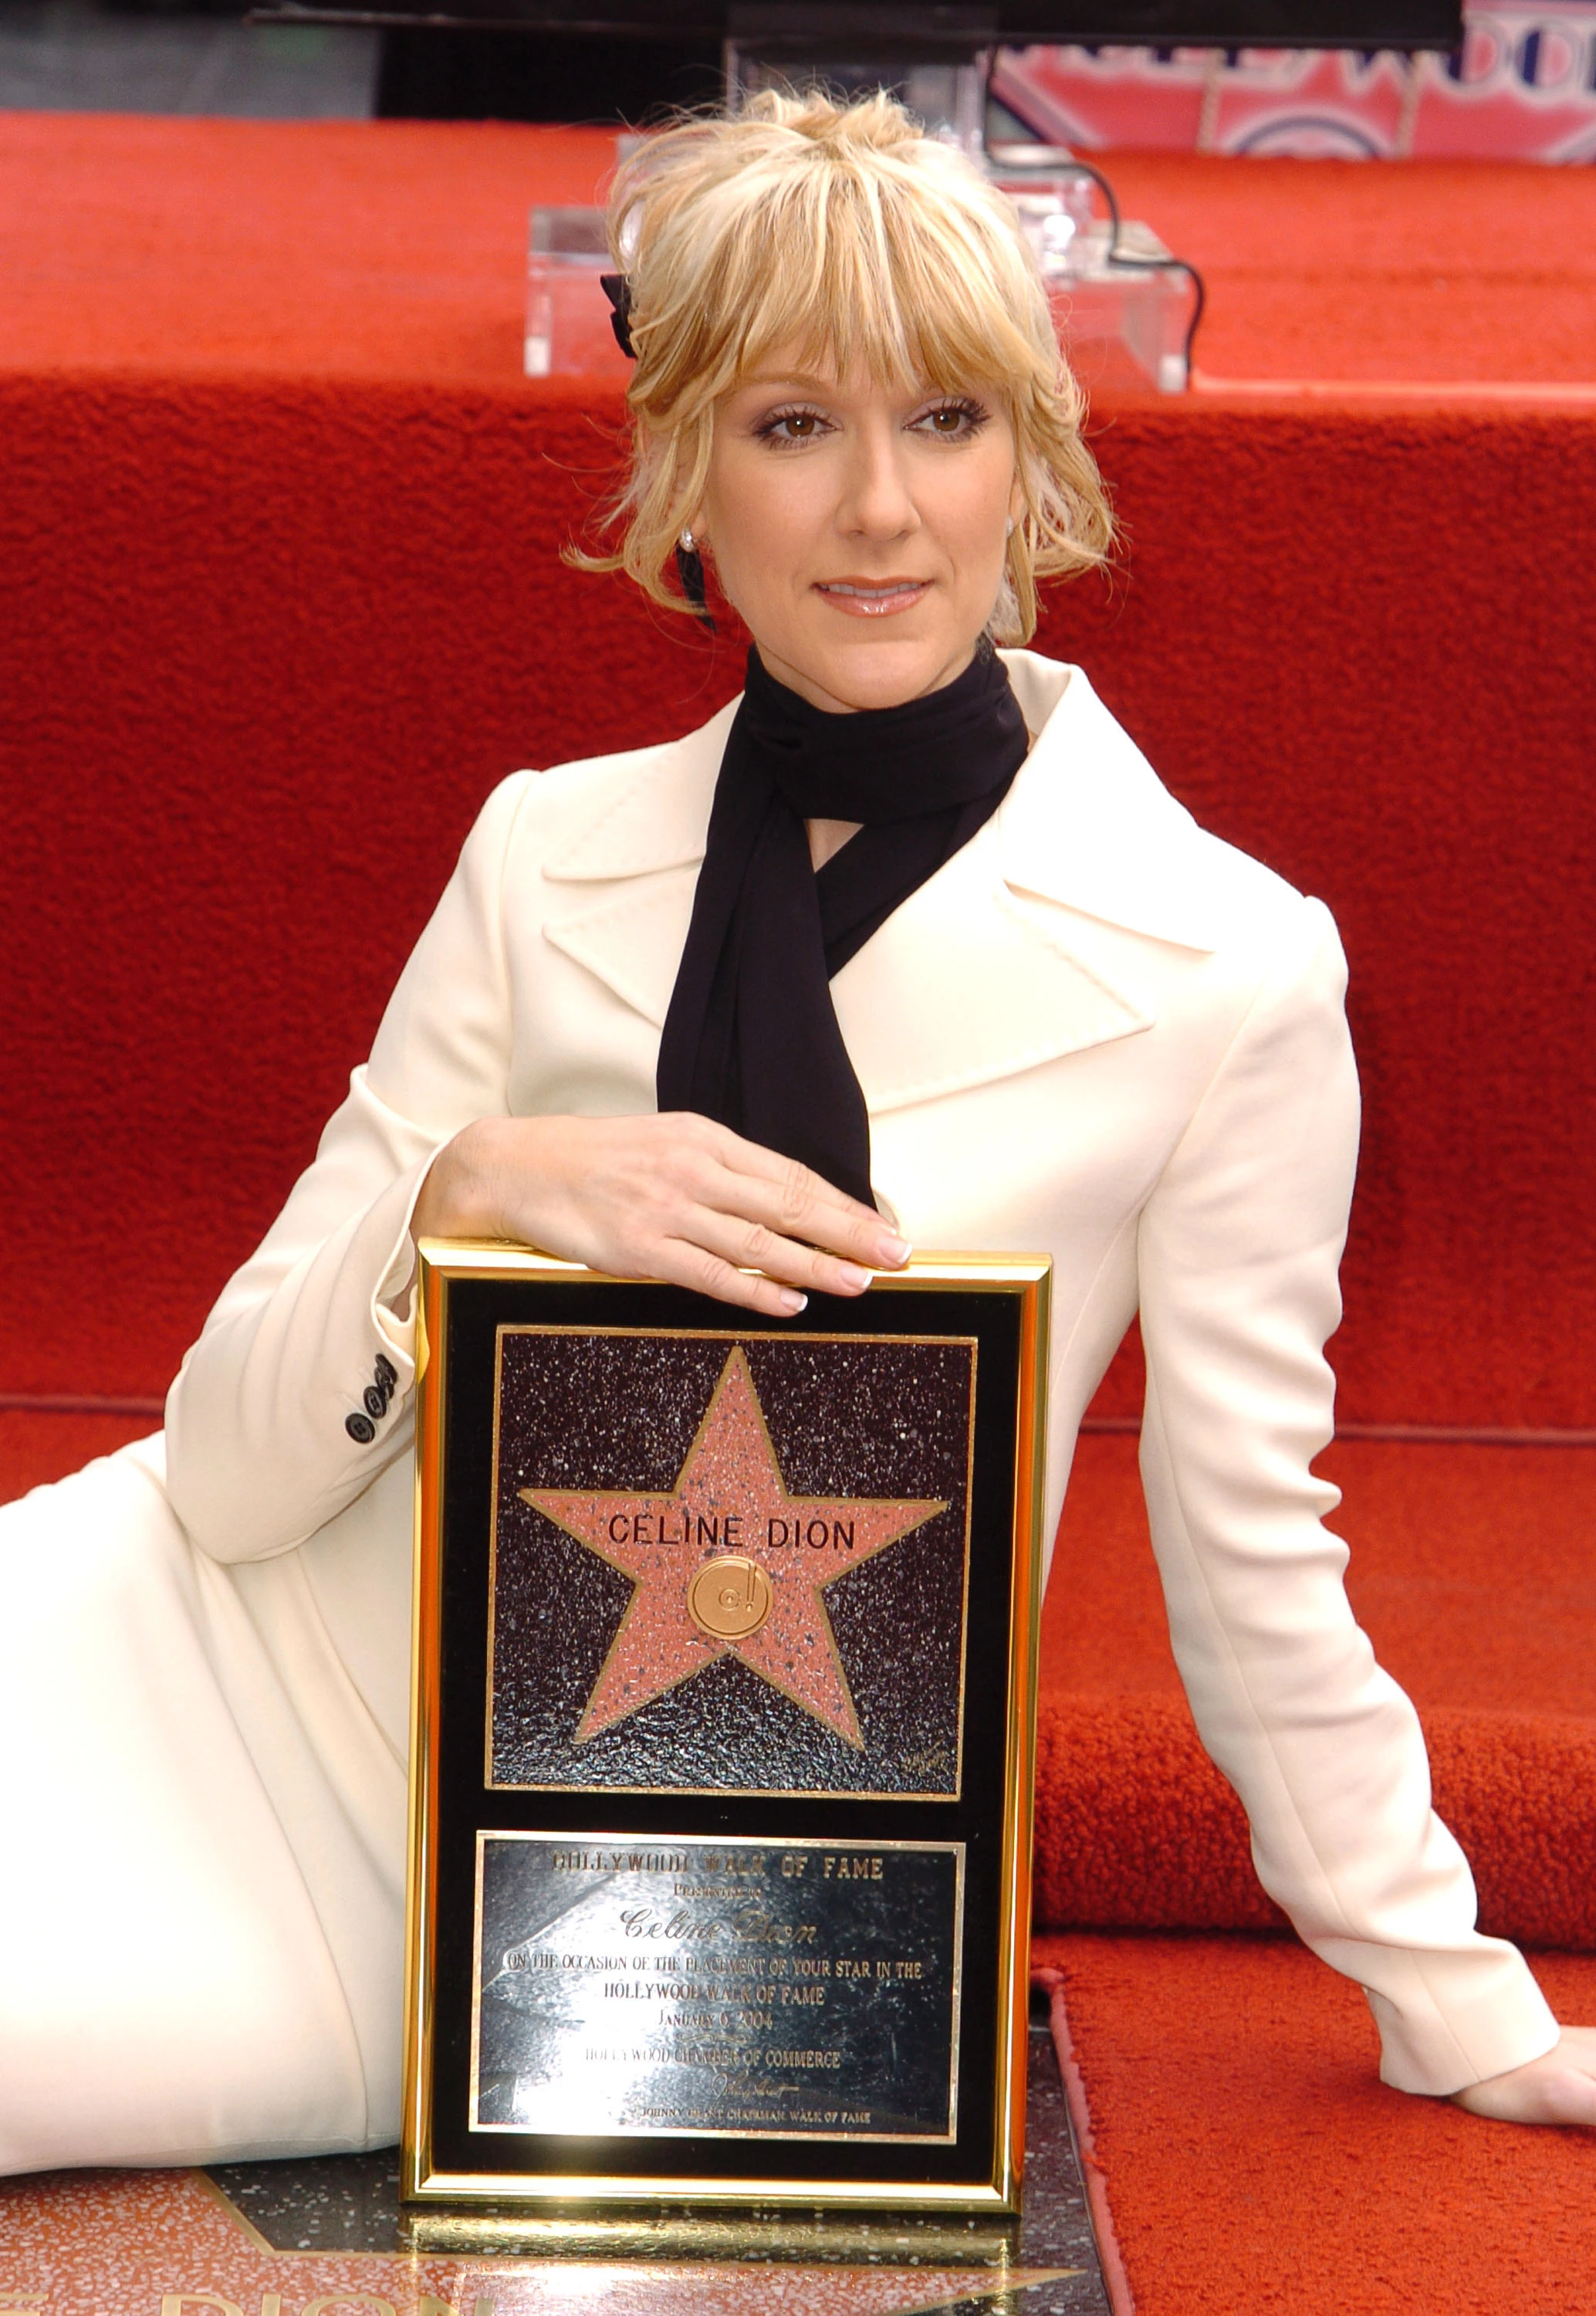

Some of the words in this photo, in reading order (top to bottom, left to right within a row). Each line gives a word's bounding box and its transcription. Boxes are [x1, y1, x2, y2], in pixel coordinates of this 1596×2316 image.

[608, 1513, 743, 1547] CELINE
[767, 1518, 856, 1550] DION
[553, 1851, 688, 1873] HOLLYWOOD
[703, 1854, 766, 1877] WALK
[781, 1854, 808, 1878] OF
[823, 1856, 884, 1881] FAME
[620, 1908, 722, 1940] Celine
[732, 1908, 817, 1944] Dion
[507, 1954, 526, 1969] ON
[532, 1954, 558, 1969] THE
[562, 1954, 627, 1970] OCCASION
[632, 1956, 650, 1971] OF
[654, 1956, 681, 1972] THE
[685, 1957, 766, 1976] PLACEMENT
[769, 1959, 787, 1976] OF
[792, 1959, 832, 1978] YOUR
[835, 1960, 872, 1979] STAR
[875, 1961, 891, 1979] IN
[894, 1962, 924, 1980] THE
[604, 1982, 701, 2001] HOLLYWOOD
[705, 1983, 752, 2003] WALK
[756, 1985, 776, 2005] OF
[780, 1986, 826, 2006] FAME
[585, 2047, 670, 2064] HOLLYWOOD
[674, 2047, 740, 2067] CHAMBER
[742, 2049, 762, 2067] OF
[764, 2050, 842, 2070] COMMERCE
[641, 2107, 685, 2119] JOHNNY
[789, 2111, 822, 2123] WALK
[824, 2111, 839, 2123] OF
[841, 2111, 872, 2124] FAME
